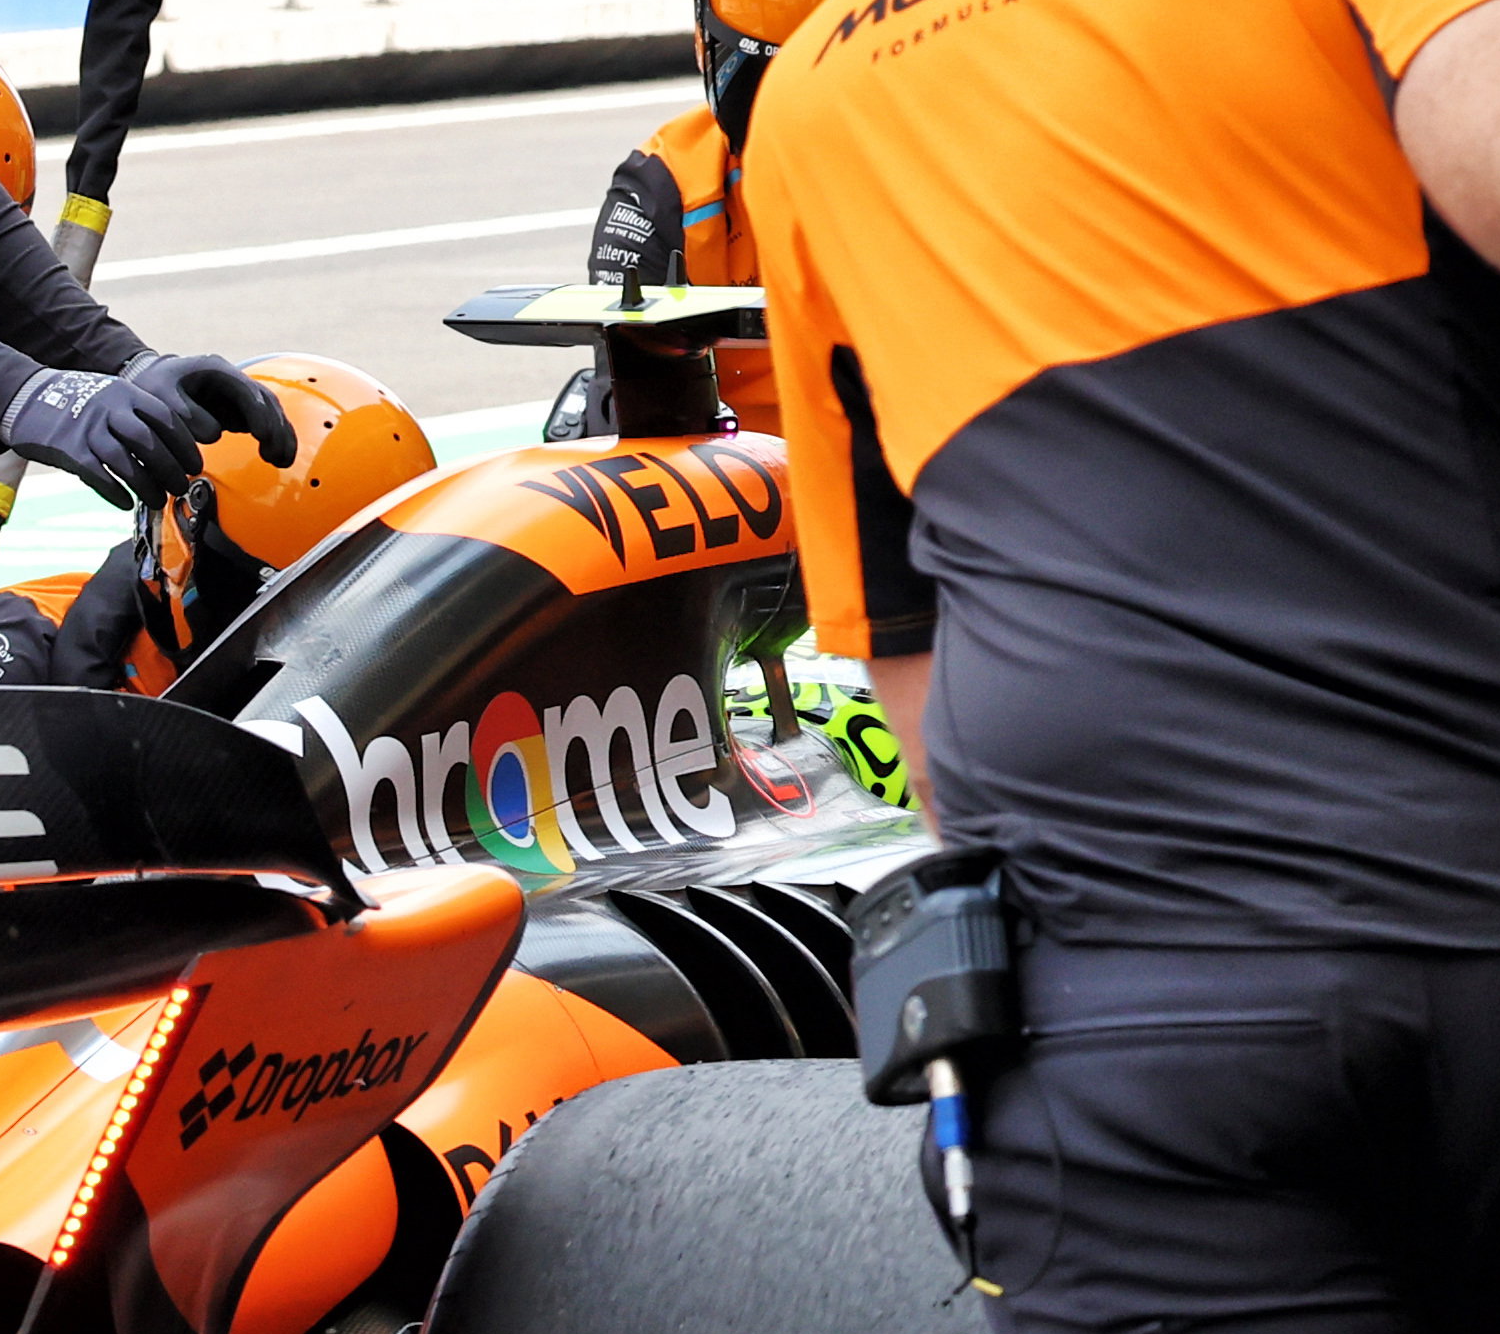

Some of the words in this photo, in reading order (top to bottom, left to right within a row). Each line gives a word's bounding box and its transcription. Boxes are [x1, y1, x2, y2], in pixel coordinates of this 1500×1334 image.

[739, 38, 759, 54] ON
[613, 208, 653, 231] Hilton
[597, 245, 641, 269] alteryx
[516, 442, 783, 573] VELO
[233, 673, 737, 880] hrome
[234, 1029, 428, 1121] Dropbox
